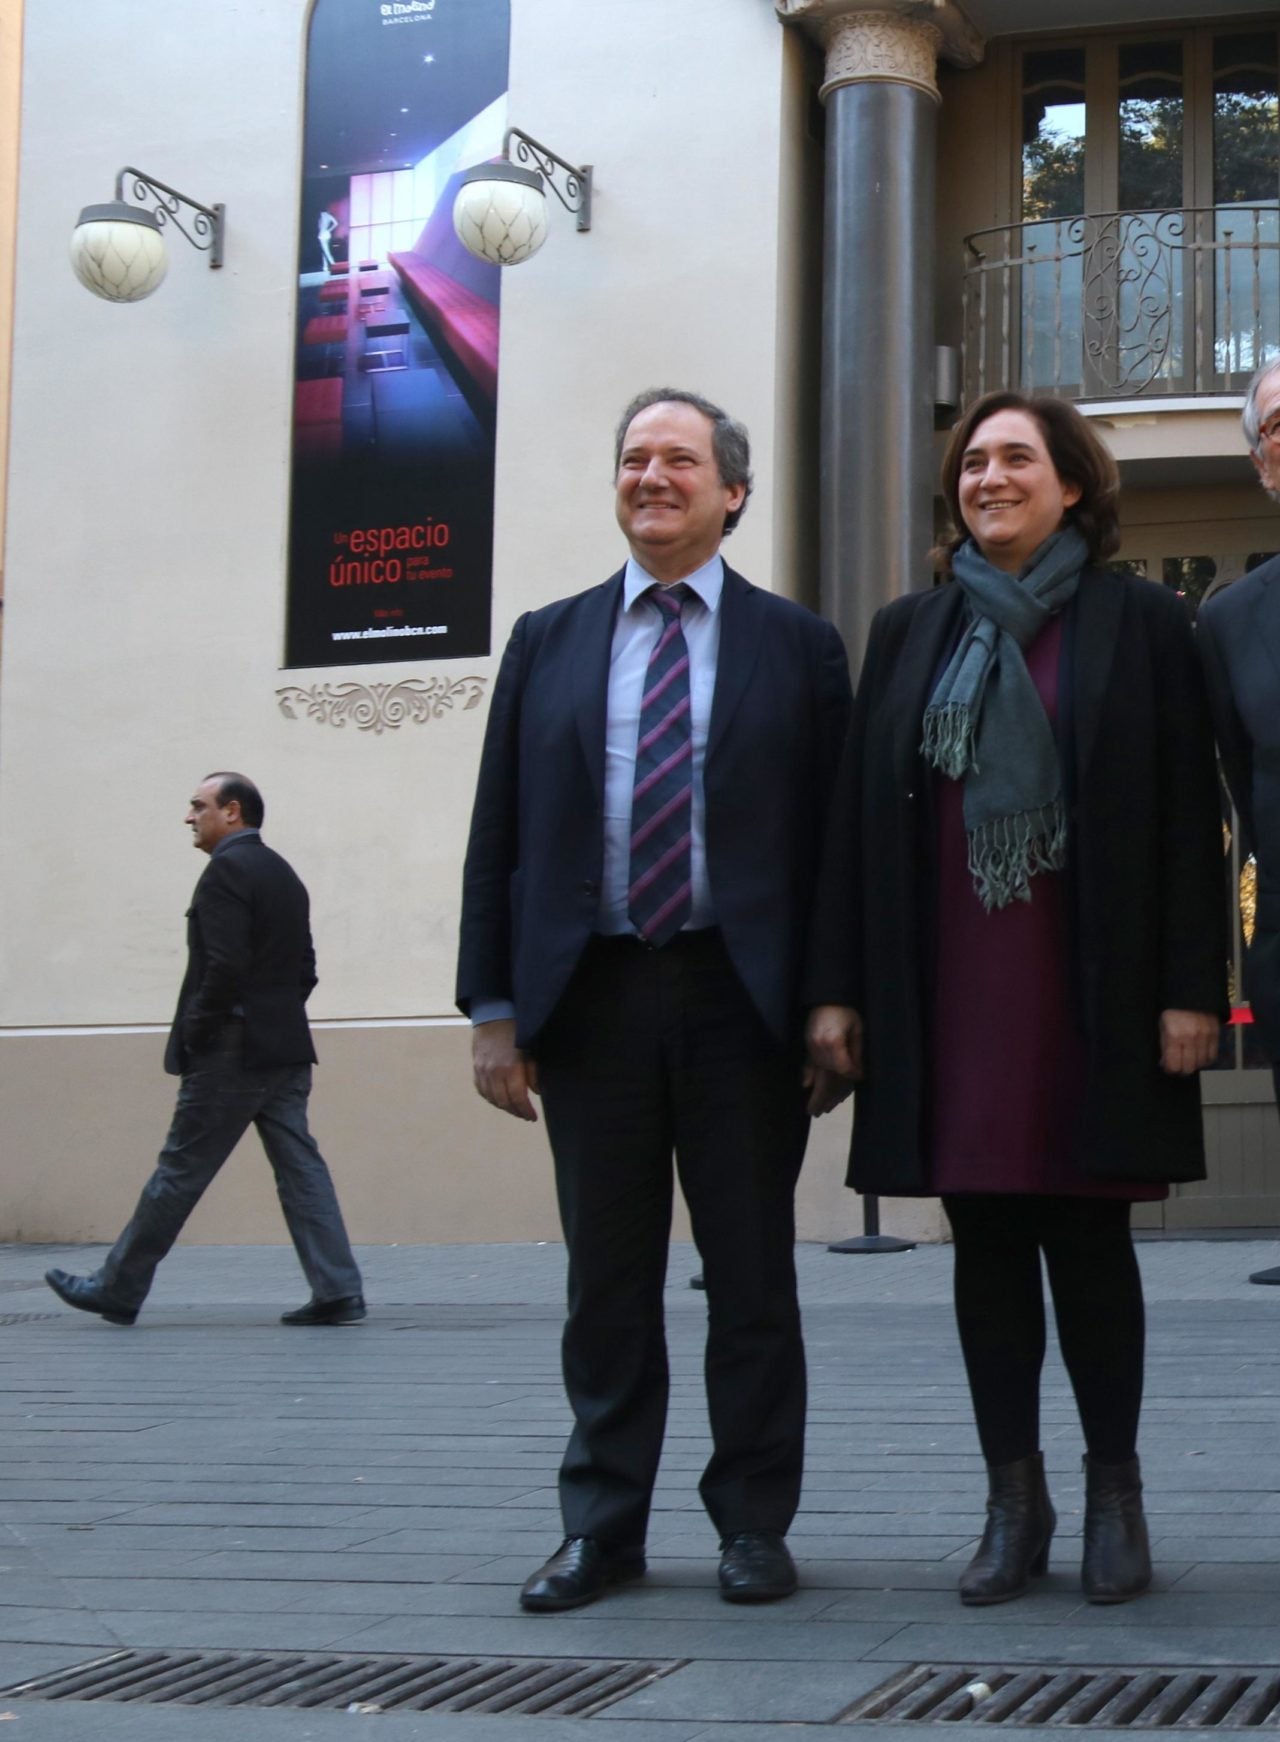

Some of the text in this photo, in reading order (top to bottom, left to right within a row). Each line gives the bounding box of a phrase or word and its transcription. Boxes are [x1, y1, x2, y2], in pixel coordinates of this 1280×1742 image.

[382, 14, 432, 26] BARCELONA
[350, 516, 449, 558] espacio
[329, 553, 401, 586] único
[406, 556, 430, 569] para
[331, 625, 448, 641] www.elmolinobcn.com
